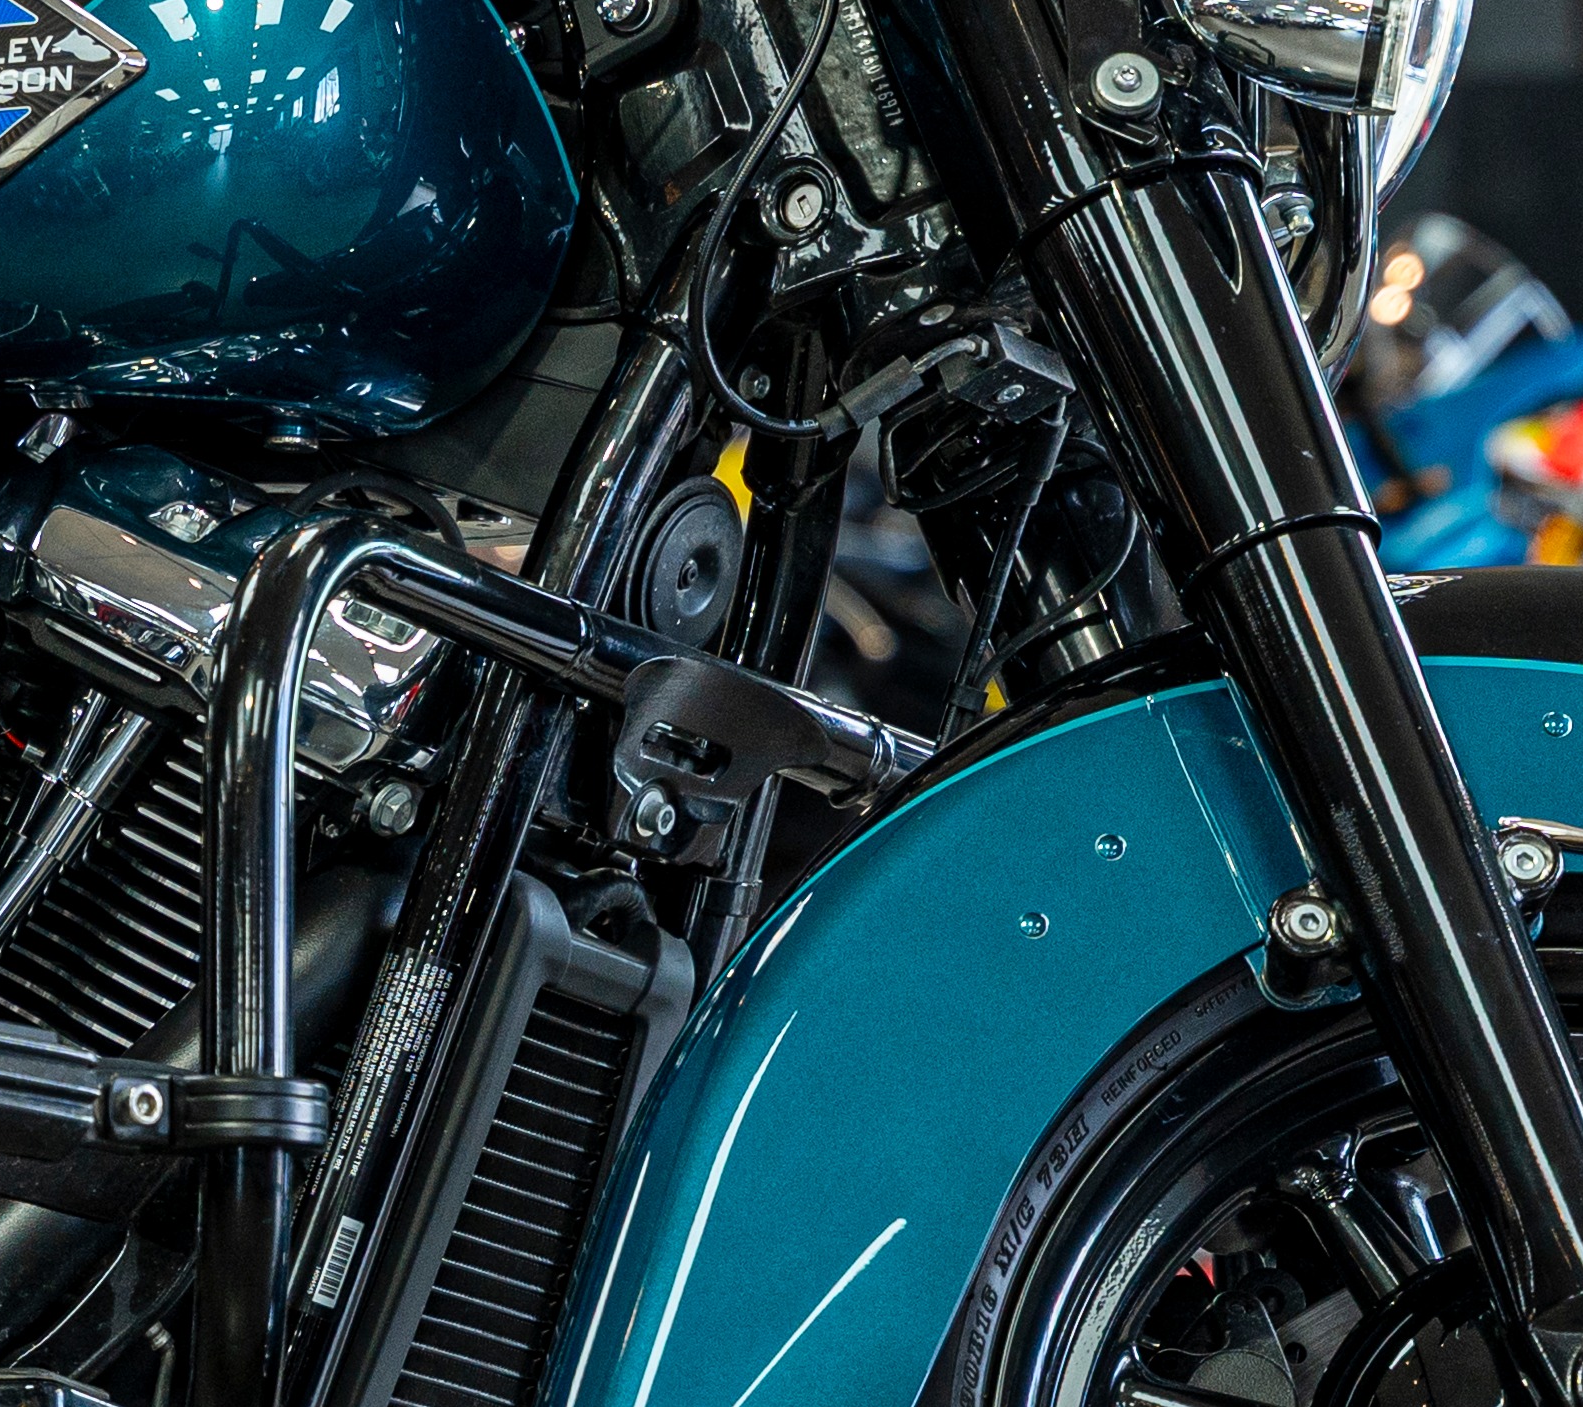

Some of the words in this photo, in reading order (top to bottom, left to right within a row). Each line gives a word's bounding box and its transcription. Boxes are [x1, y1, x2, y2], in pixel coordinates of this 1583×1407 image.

[1101, 1031, 1182, 1107] REINFORCED
[994, 1197, 1036, 1278] M/C
[1036, 1114, 1091, 1190] 73H
